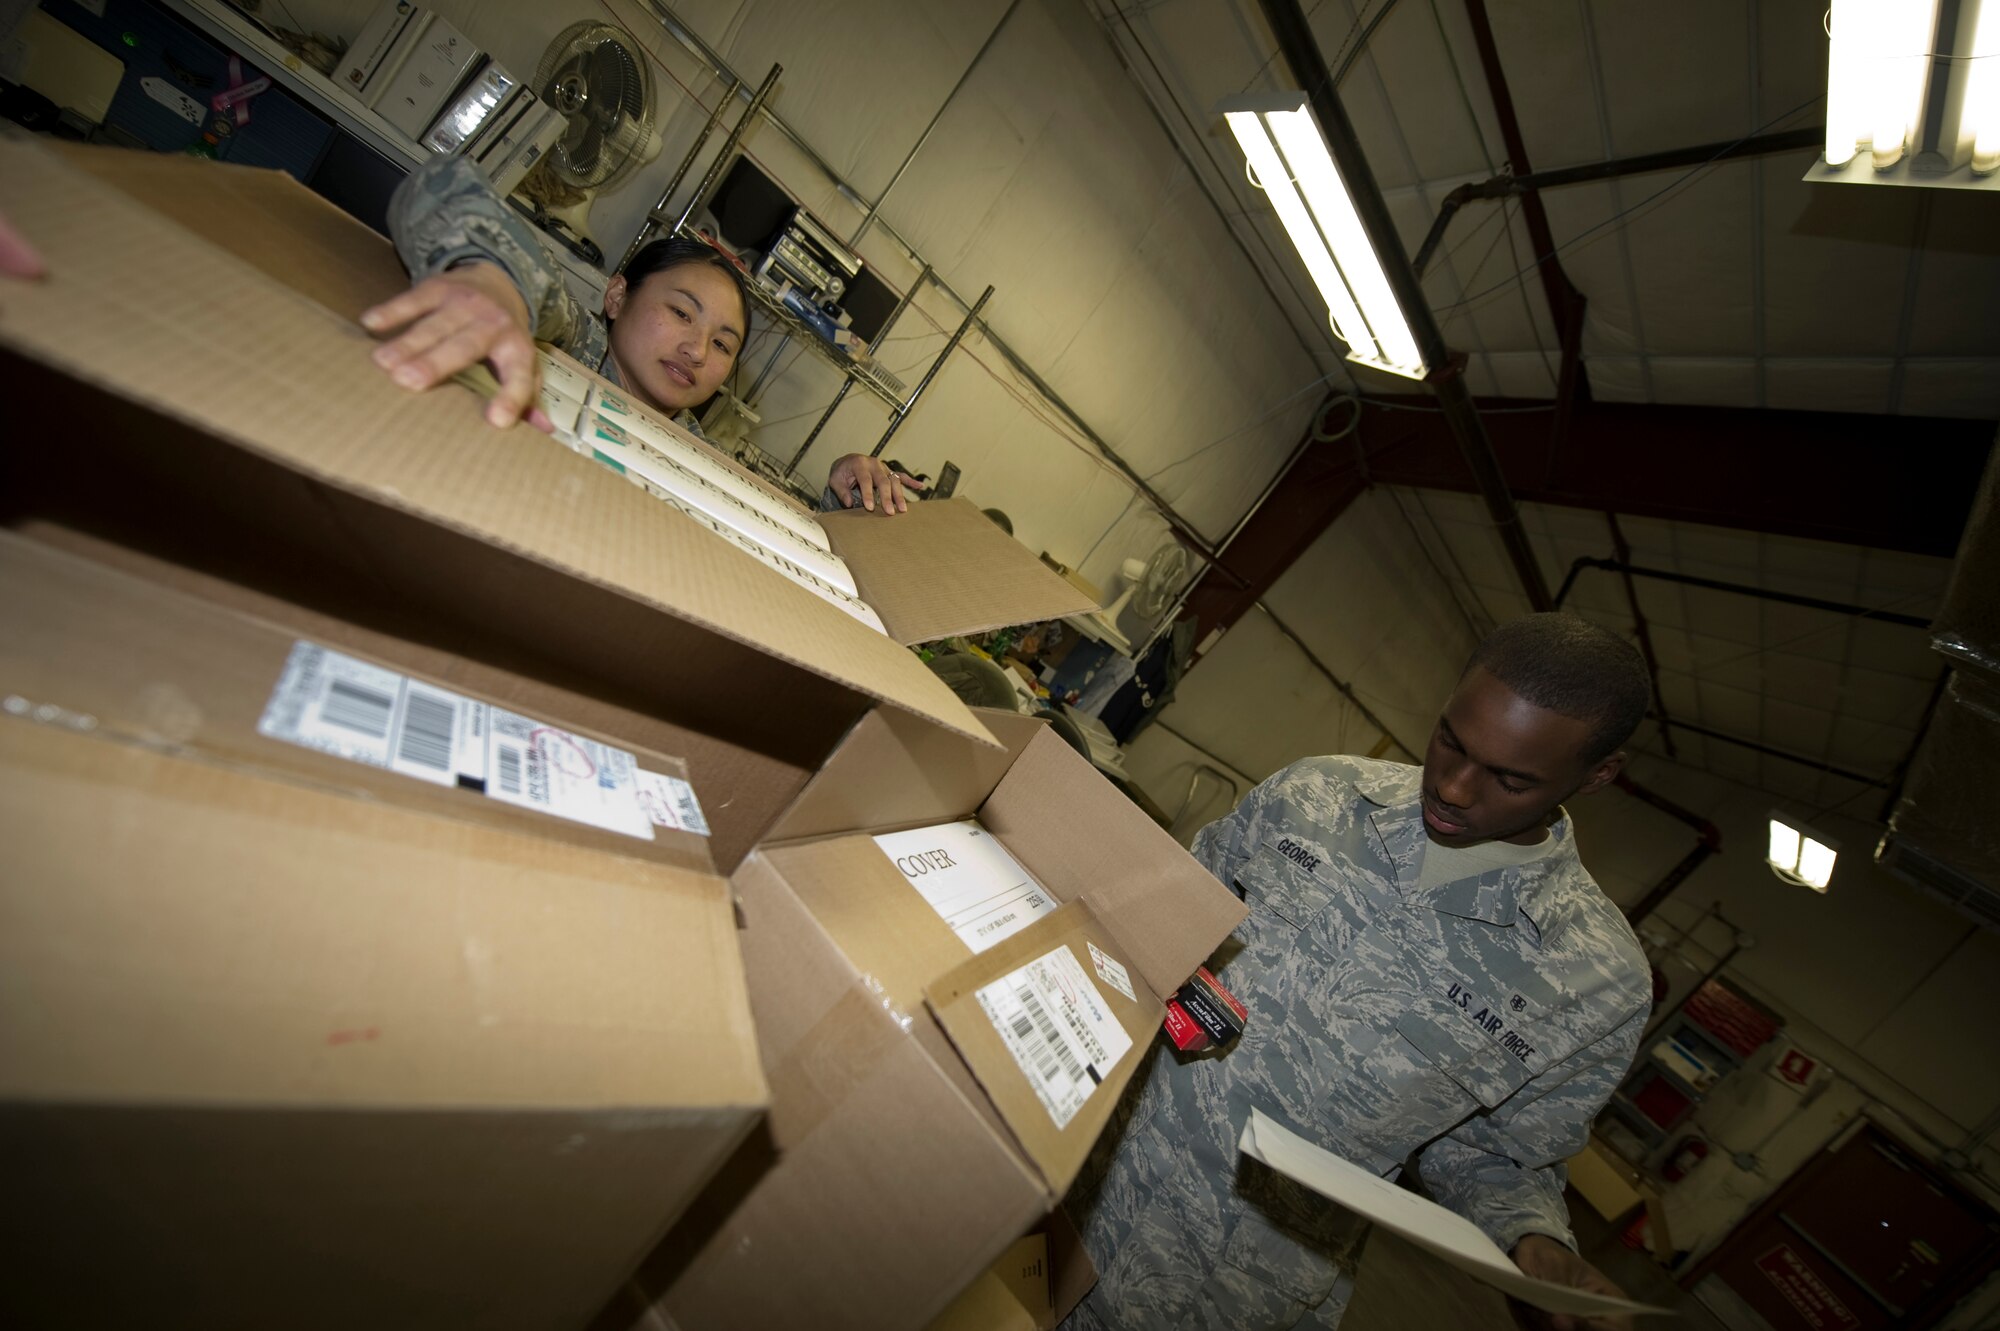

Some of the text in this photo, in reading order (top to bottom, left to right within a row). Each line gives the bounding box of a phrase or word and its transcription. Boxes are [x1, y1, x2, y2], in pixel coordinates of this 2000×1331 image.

[640, 415, 707, 458] FACE
[711, 458, 812, 523] SHIELDS
[640, 442, 716, 493] FACE
[721, 490, 835, 561] SHIELDS
[643, 482, 732, 538] FACE
[736, 535, 866, 612] SHIELDS
[896, 848, 957, 878] COVER
[1278, 839, 1320, 872] GEORGE
[1448, 983, 1535, 1063] U.S. AIR FORCE
[1766, 1269, 1825, 1328] ACTIVATED
[1787, 1274, 1825, 1312] ALARM
